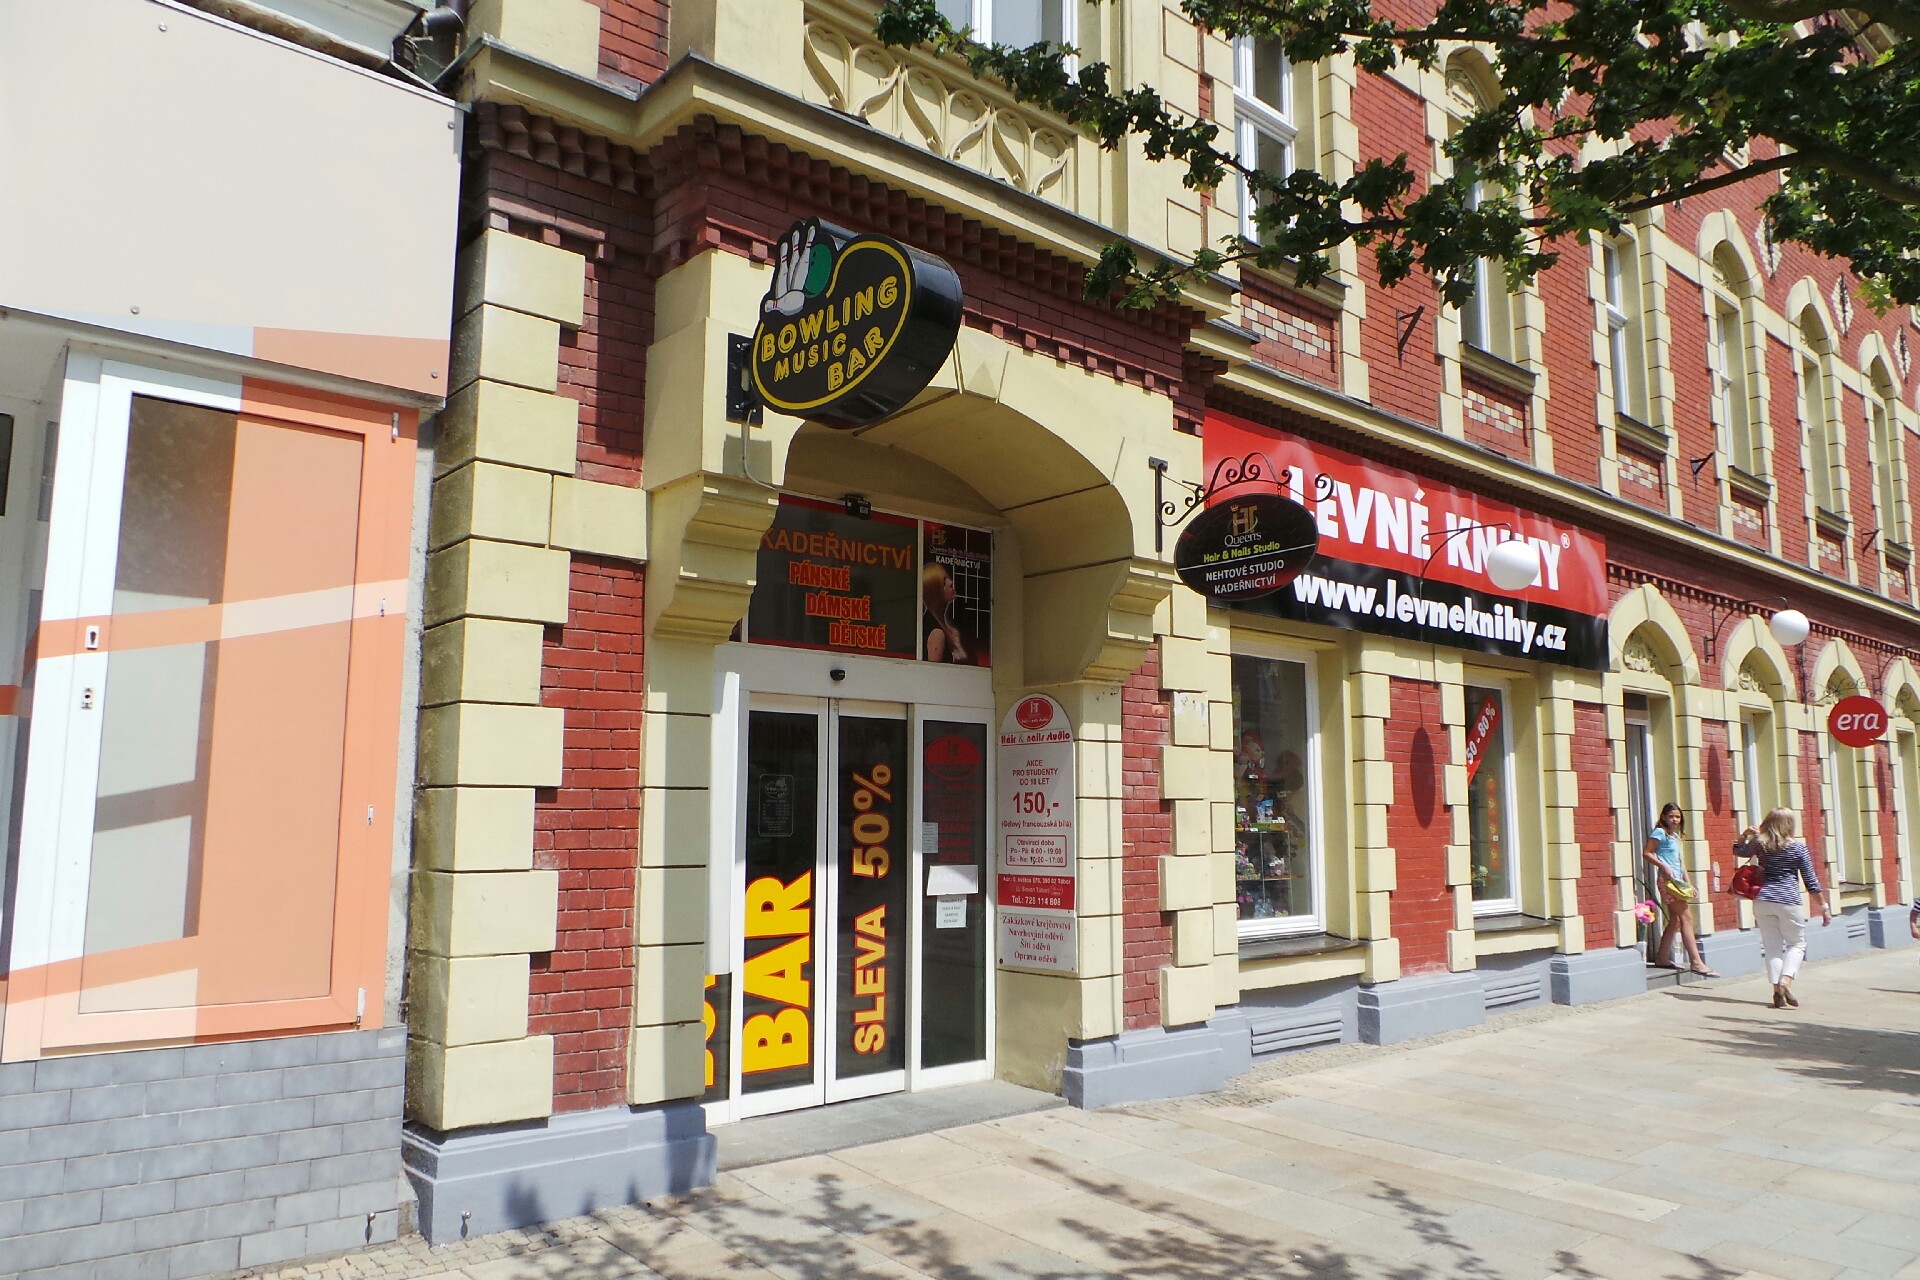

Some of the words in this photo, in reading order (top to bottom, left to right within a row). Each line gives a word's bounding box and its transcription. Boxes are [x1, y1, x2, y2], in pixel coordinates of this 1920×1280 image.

[762, 275, 897, 362] BOWLING
[774, 333, 847, 382] MUSIC
[828, 326, 884, 391] BAR
[1203, 553, 1220, 564] Hair
[1222, 550, 1229, 560] &
[1231, 547, 1251, 559] Nails
[1253, 541, 1280, 554] Studio
[1445, 512, 1560, 591] KNY
[789, 559, 851, 591] PÁNSKÉ
[1206, 564, 1247, 582] NEHTOVÉ
[1249, 559, 1285, 573] STUDIO
[1214, 573, 1276, 594] KADEŘNICTVÍ
[805, 591, 871, 621] DÁMSKÉ
[1293, 574, 1567, 654] www.levneknihy.cz
[829, 620, 887, 650] DĚTSKÉ
[1478, 715, 1489, 738] 80
[1485, 703, 1496, 720] %
[1837, 713, 1880, 730] era
[1001, 734, 1016, 744] Hair
[1026, 733, 1045, 742] nails
[1046, 731, 1071, 741] studio
[1026, 768, 1058, 776] STUDENTY
[1038, 777, 1050, 785] LET
[1012, 791, 1059, 817] 150,-
[852, 763, 892, 879] 50%
[1022, 820, 1057, 828] francouzská
[1038, 897, 1049, 905] 114
[1002, 915, 1035, 925] Zakázkové
[1036, 919, 1071, 930] krejčovství
[1008, 928, 1044, 938] Navrhování
[1044, 931, 1064, 941] oděvů
[1020, 938, 1031, 949] Šití
[1032, 941, 1051, 951] oděvů
[1014, 951, 1036, 961] Oprava
[1038, 954, 1057, 963] oděvů
[742, 869, 812, 1074] BAR
[853, 903, 887, 1055] SLEVA
